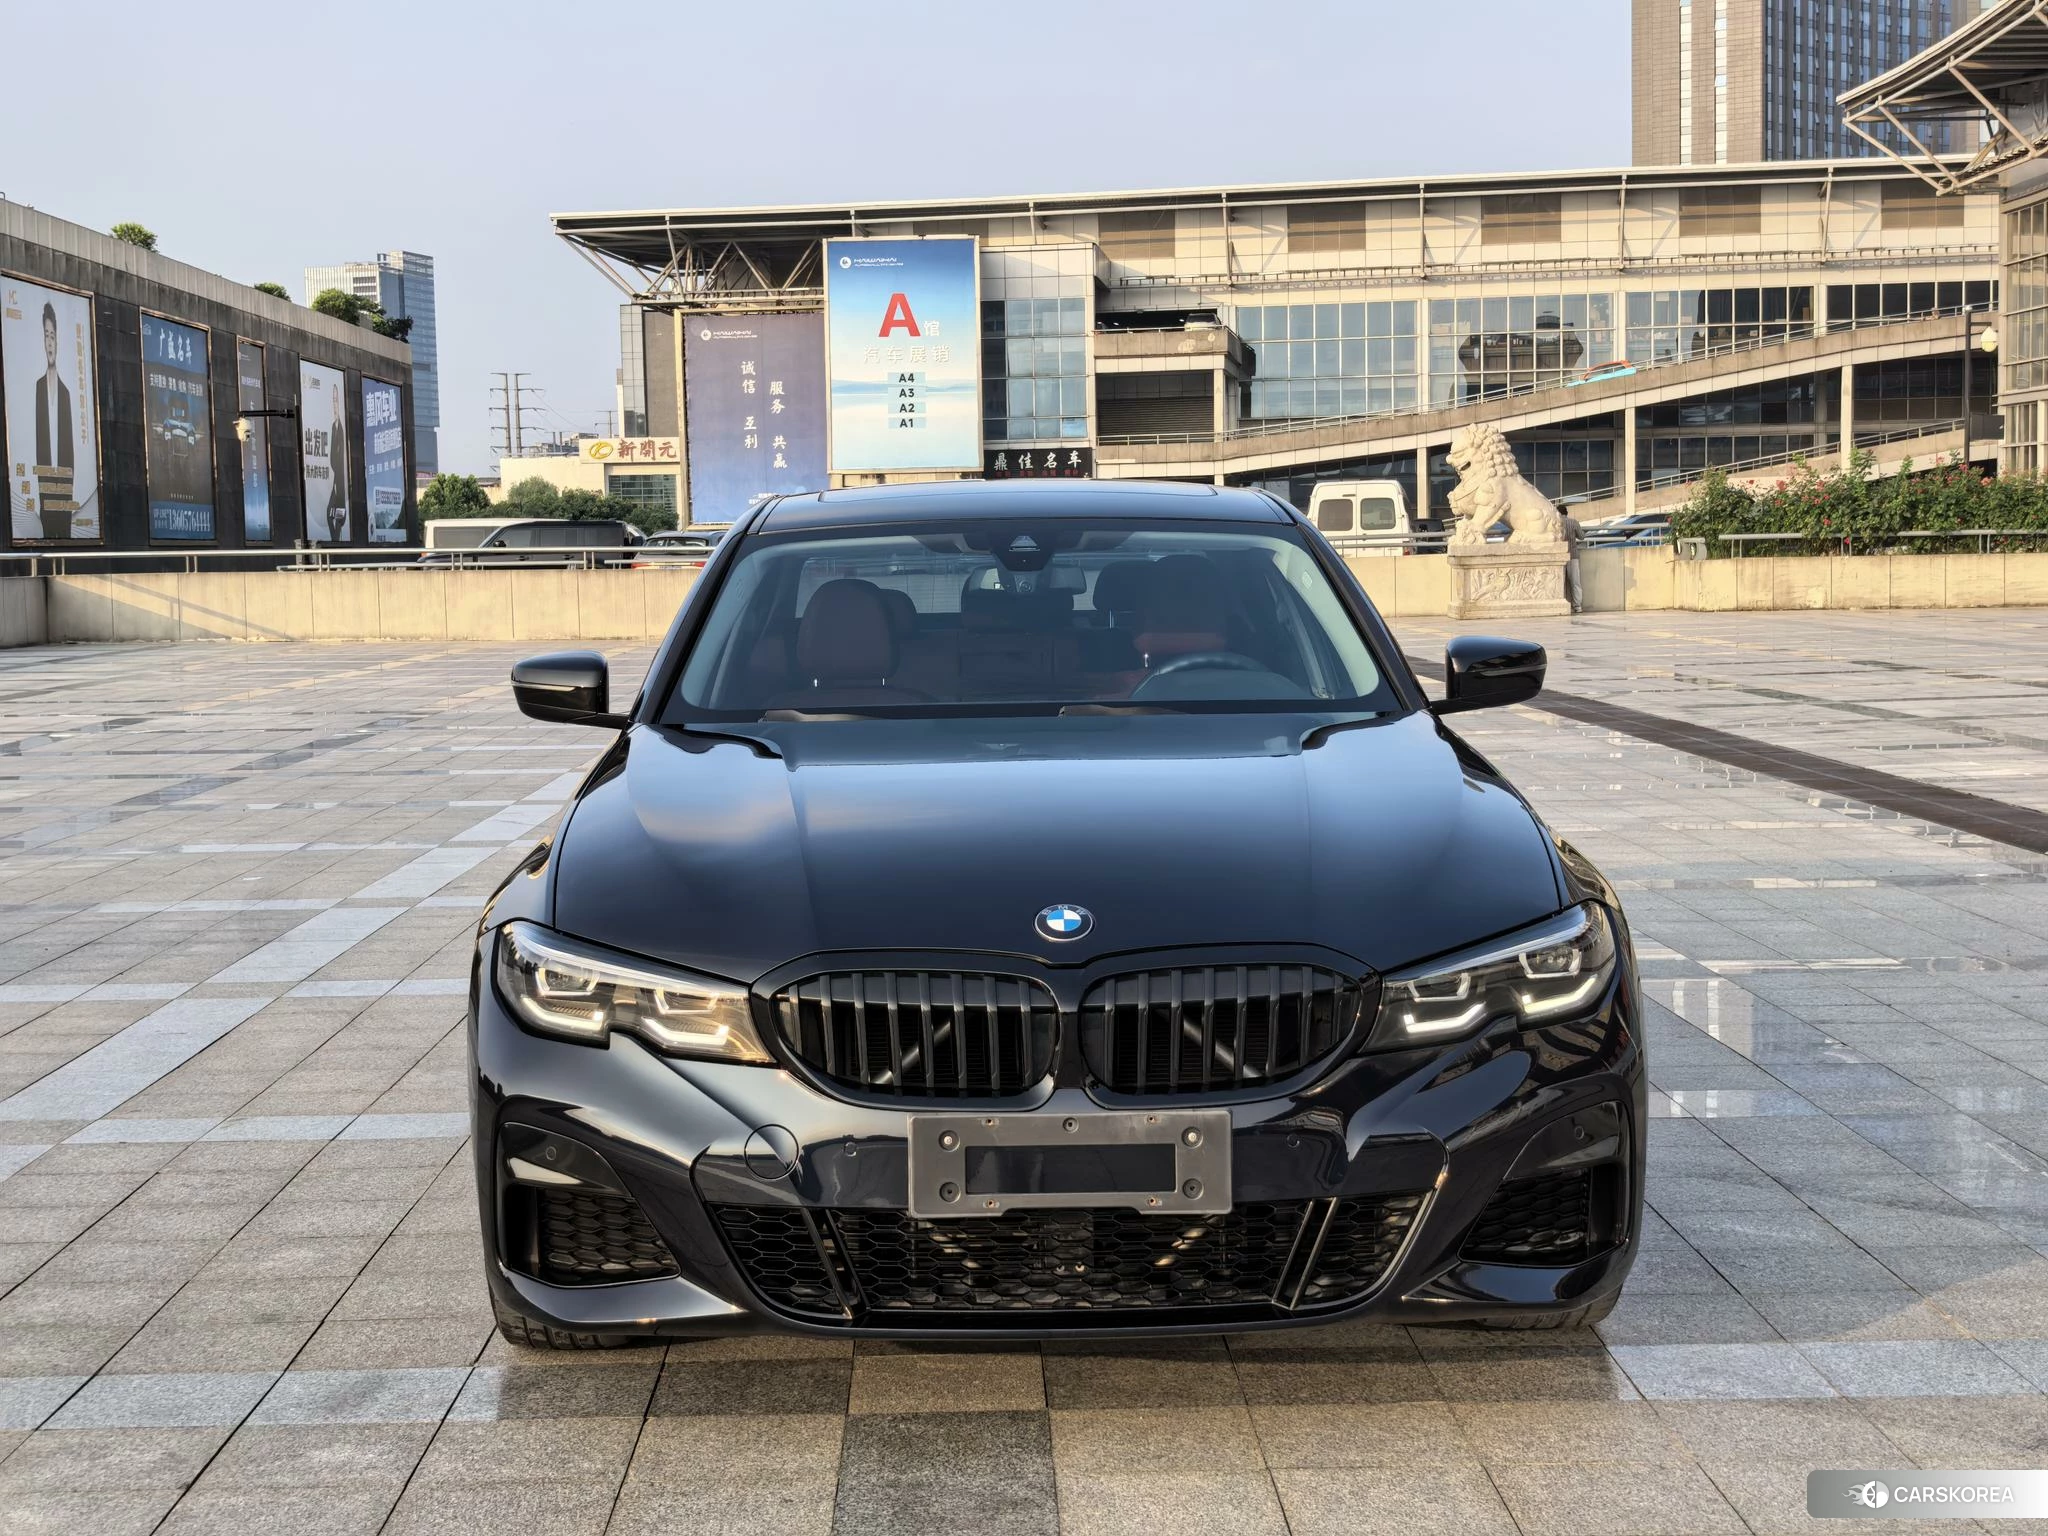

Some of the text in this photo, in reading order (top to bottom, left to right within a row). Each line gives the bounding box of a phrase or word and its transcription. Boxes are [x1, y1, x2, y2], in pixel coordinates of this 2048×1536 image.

[863, 344, 952, 364] 汽车展销
[899, 373, 915, 383] A4
[899, 388, 915, 398] A3
[741, 361, 758, 449] 诚信 互利
[900, 403, 915, 413] A2
[770, 381, 788, 469] 服务 共赢
[900, 418, 914, 428] A1
[305, 428, 329, 458] 出发吧
[995, 450, 1082, 471] 鼎佳名车
